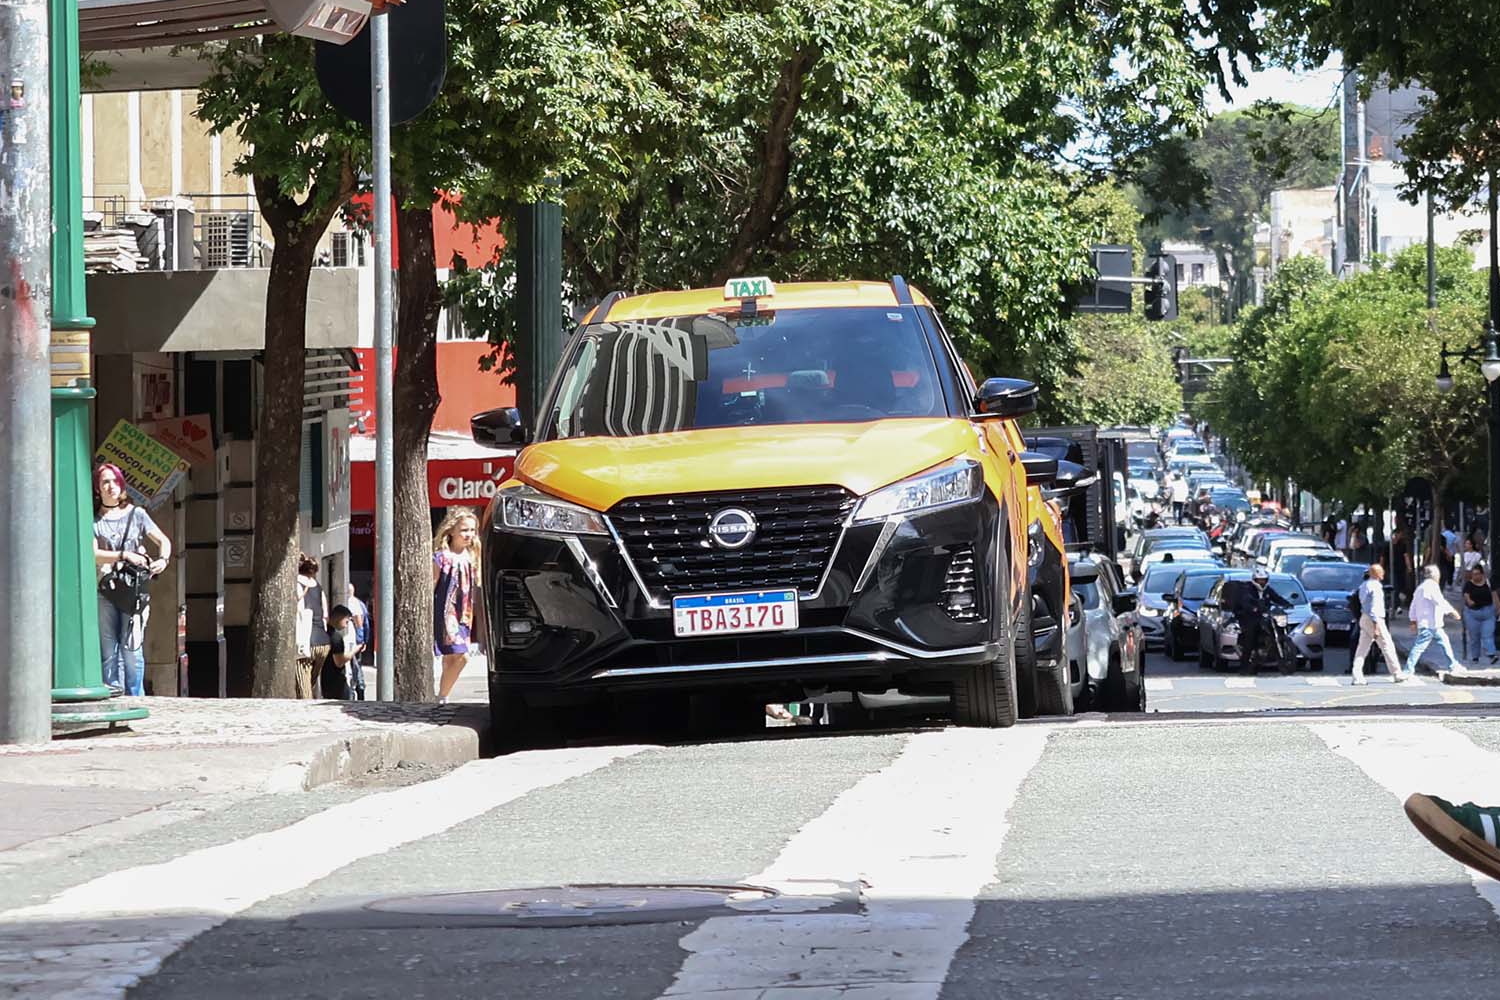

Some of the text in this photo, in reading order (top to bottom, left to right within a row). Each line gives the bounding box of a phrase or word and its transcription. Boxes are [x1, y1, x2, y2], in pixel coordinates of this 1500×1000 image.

[730, 279, 767, 297] TAXI
[104, 442, 164, 484] CHOCOLATE
[112, 431, 171, 474] ITALIANO
[121, 423, 177, 463] SORVETE
[96, 454, 156, 496] BNILHA
[439, 469, 500, 500] Claro
[709, 523, 755, 534] NISSAN
